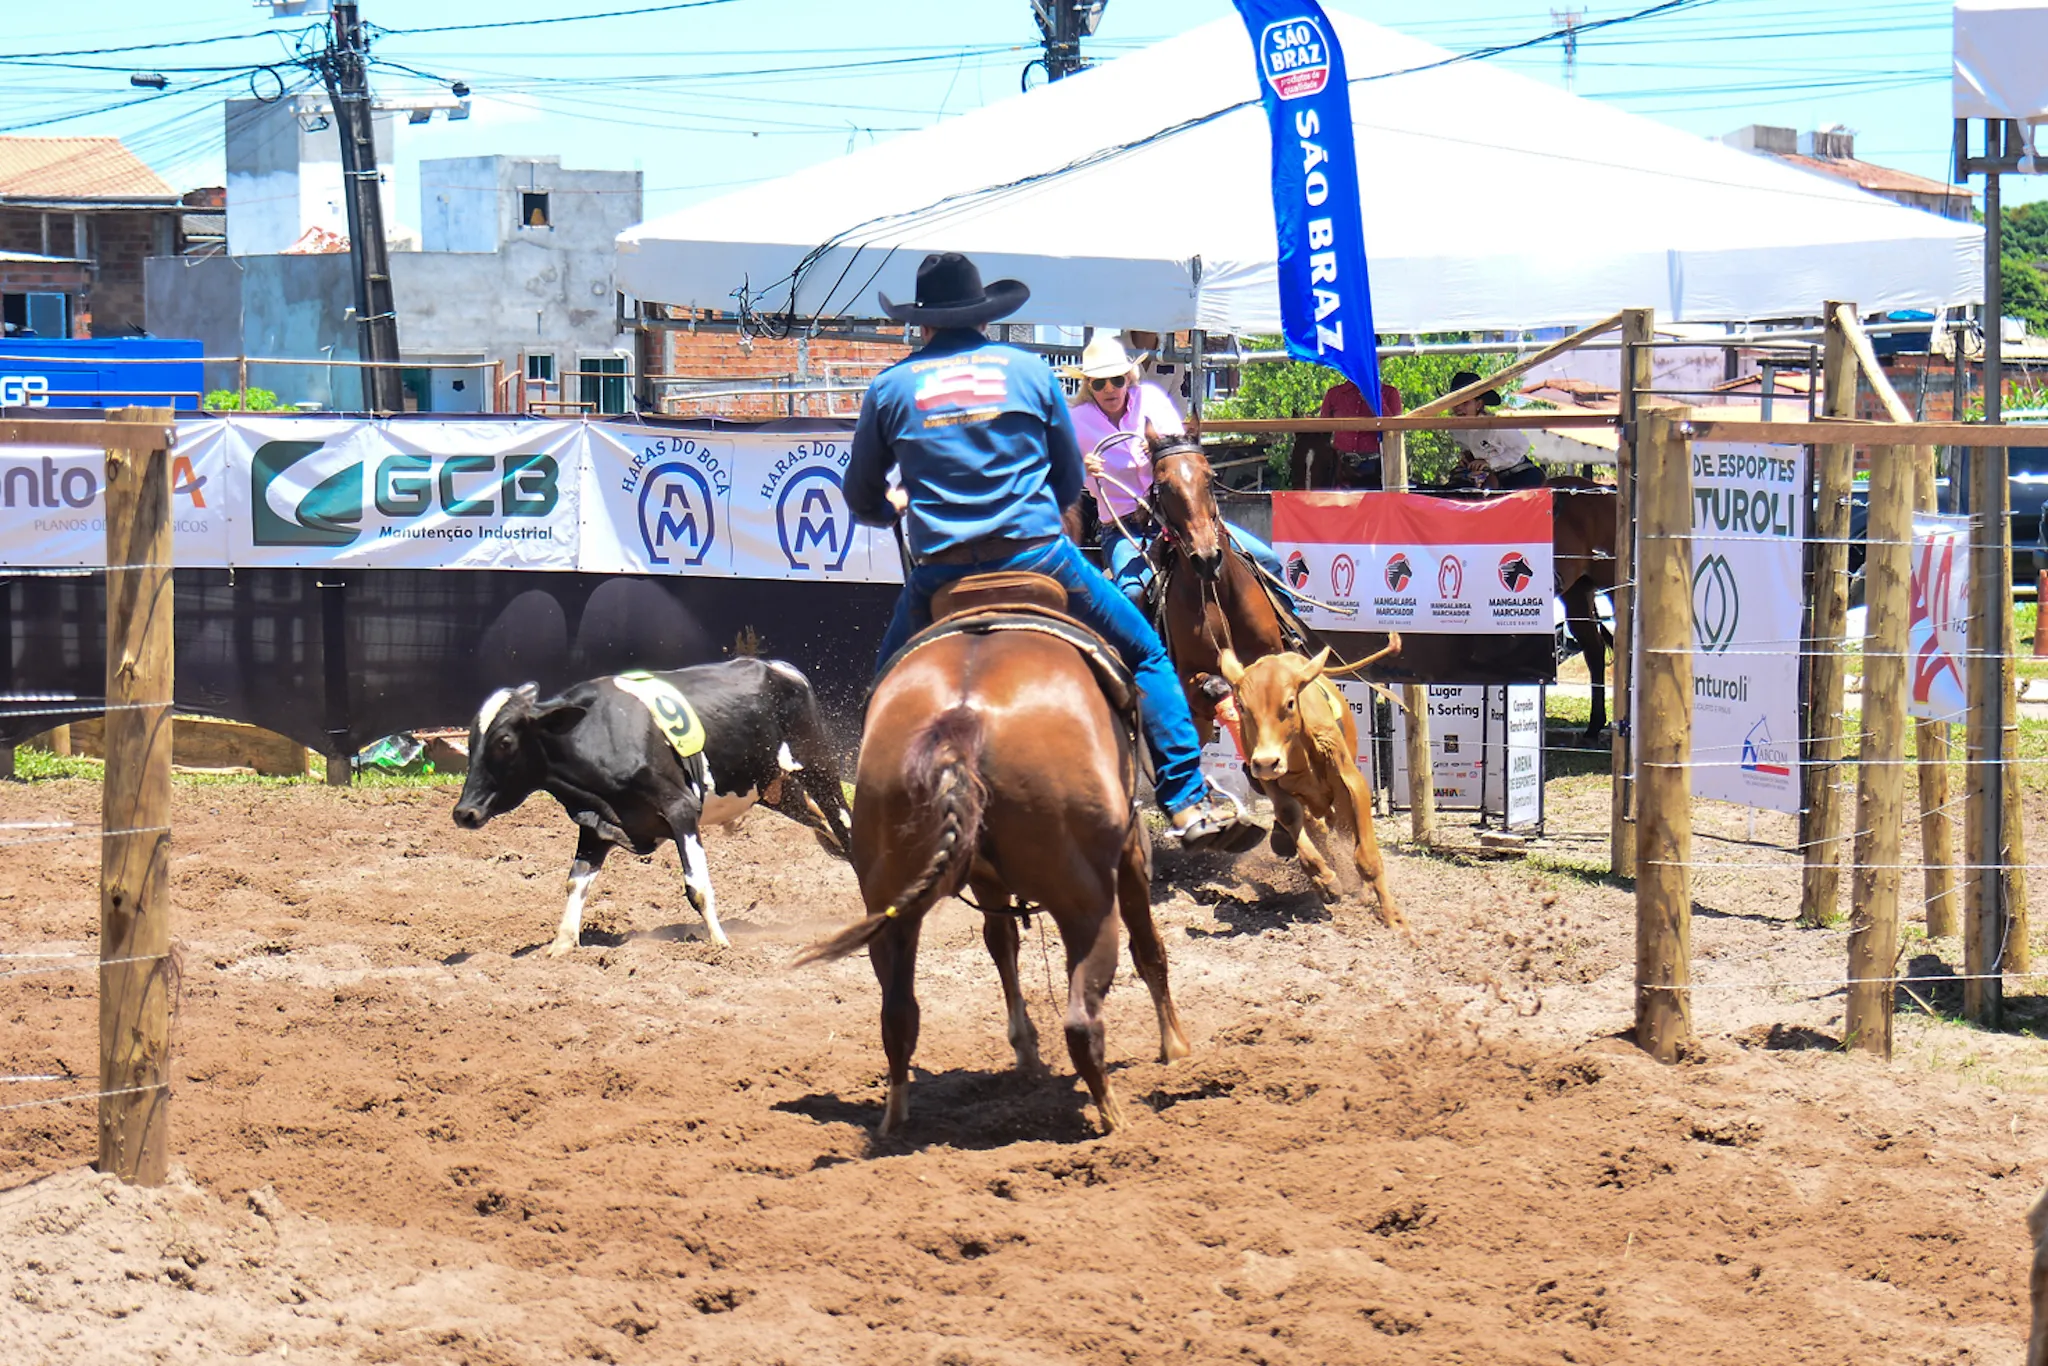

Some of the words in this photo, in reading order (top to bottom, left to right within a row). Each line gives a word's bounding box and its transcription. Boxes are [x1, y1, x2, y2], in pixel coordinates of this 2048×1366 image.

[1272, 24, 1311, 50] SÃO
[1270, 44, 1322, 72] BRAZ
[1295, 108, 1329, 206] SÃO
[1308, 217, 1345, 356] BRAZ
[622, 440, 667, 494] HARAS
[671, 437, 696, 456] DO
[697, 447, 731, 497] BOCA
[760, 444, 808, 500] HARAS
[812, 441, 837, 459] DO
[1693, 454, 1715, 478] DE
[1717, 454, 1796, 483] ESPORTES
[0, 456, 98, 509] nto
[375, 453, 560, 518] GCB
[34, 519, 89, 532] PLANOS
[1691, 487, 1795, 538] TUROLI
[379, 525, 474, 542] Manutenção
[479, 525, 553, 540] Industrial
[1374, 597, 1417, 606] MANGALARGA
[1376, 608, 1415, 617] MARCHADOR
[1430, 602, 1472, 610] MANGALARGA
[1489, 597, 1544, 607] MANGALARGA
[1493, 608, 1541, 617] MARCHADOR
[1429, 684, 1463, 700] Lugar
[1692, 673, 1748, 703] nturoli
[655, 694, 691, 737] 9
[1437, 702, 1480, 718] Sorting
